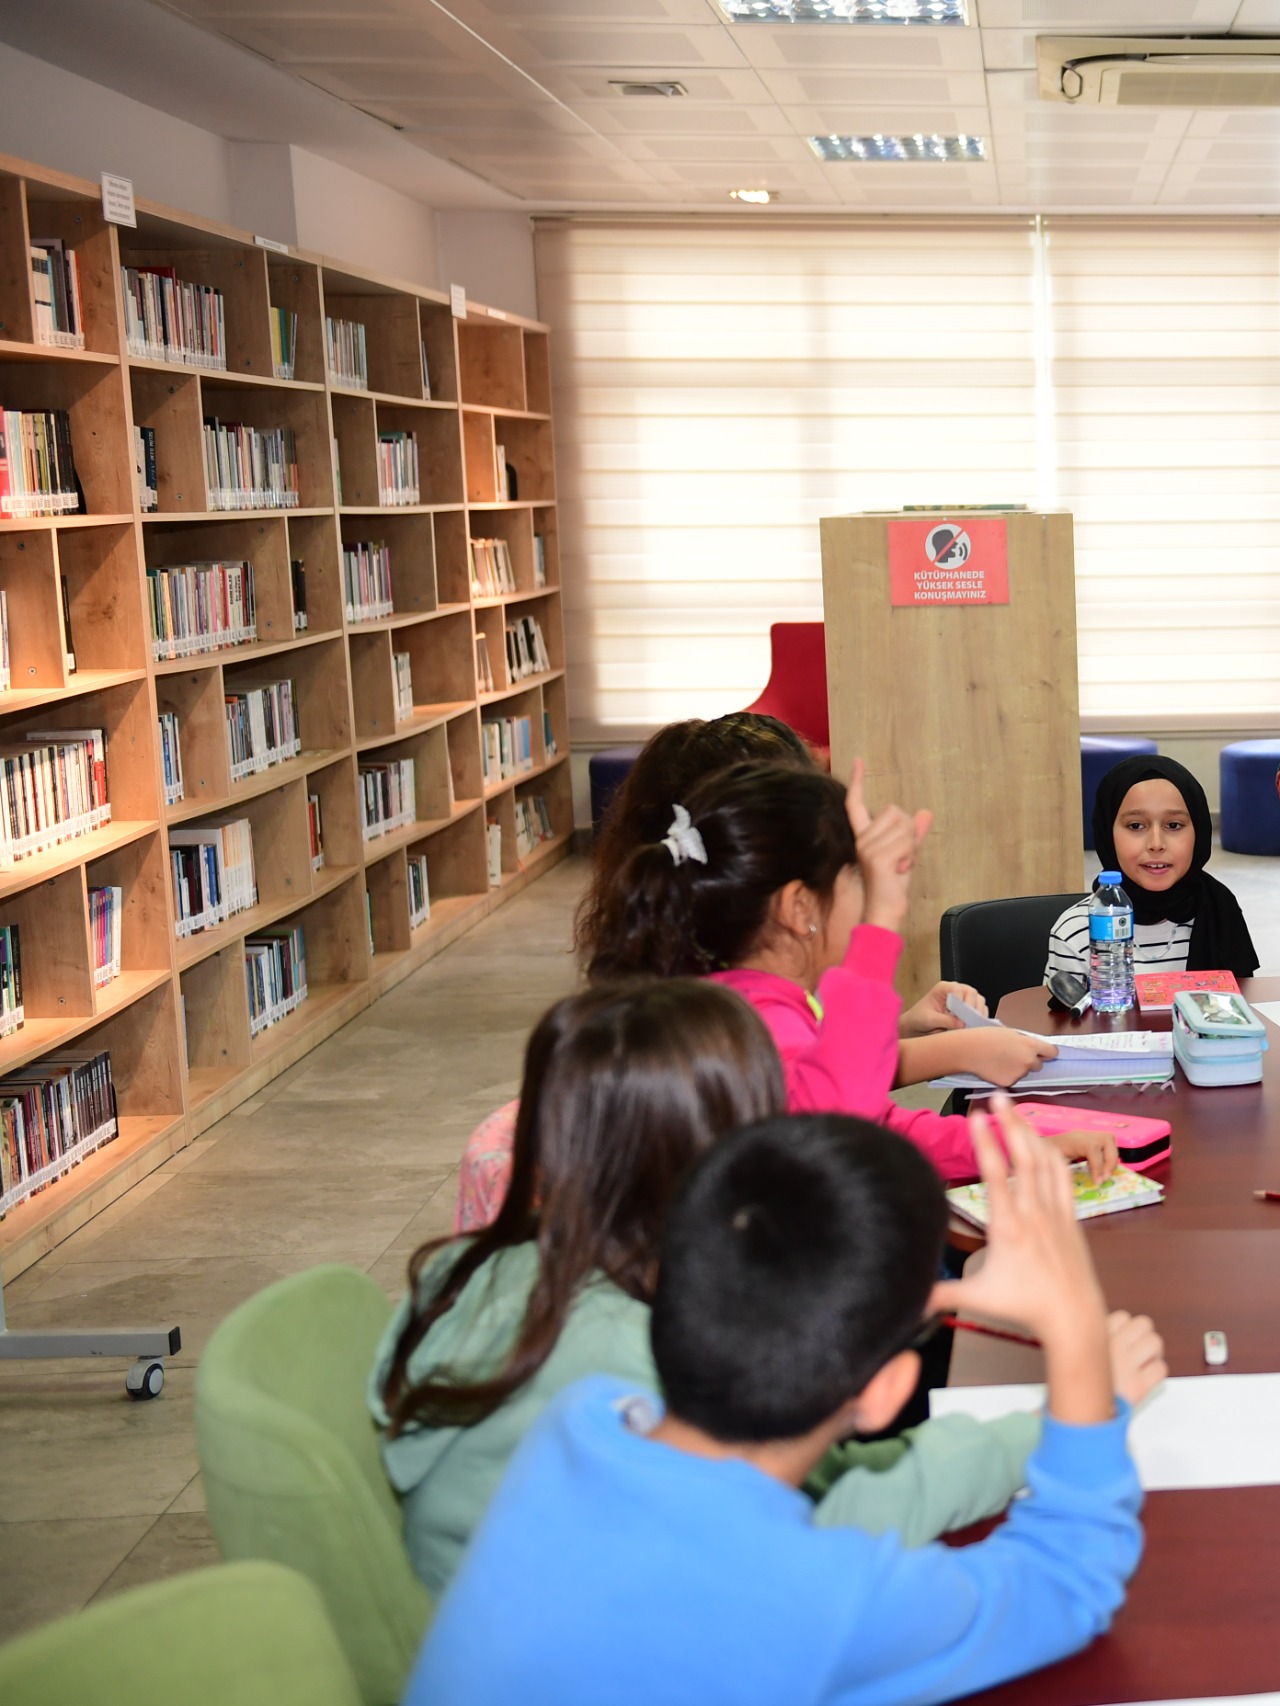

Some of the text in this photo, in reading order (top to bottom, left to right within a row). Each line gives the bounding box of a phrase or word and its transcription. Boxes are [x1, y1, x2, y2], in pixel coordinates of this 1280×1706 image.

[914, 571, 985, 580] KÜTÜPHANEDE
[917, 580, 983, 589] YÜKSEK SESLE
[914, 590, 986, 601] KONUŞMAYINIZ
